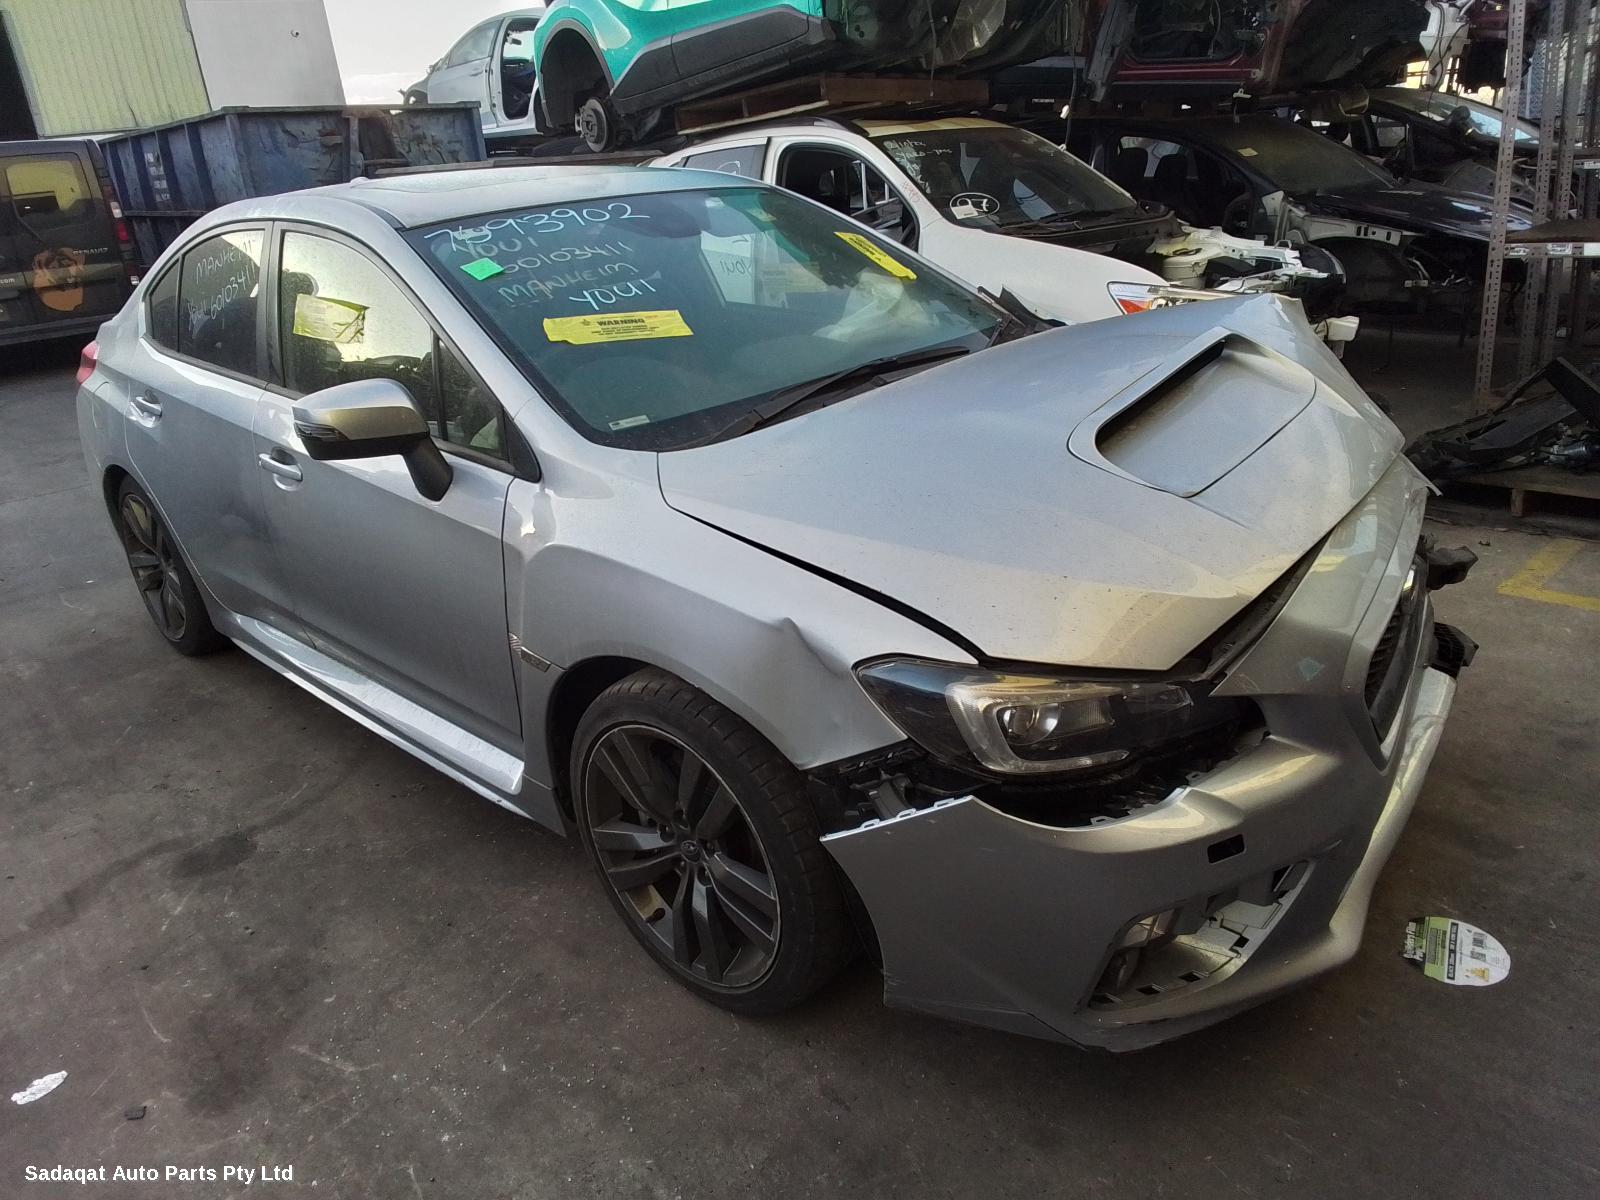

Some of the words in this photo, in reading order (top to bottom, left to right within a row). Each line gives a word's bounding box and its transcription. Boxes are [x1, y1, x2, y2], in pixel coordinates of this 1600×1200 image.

[497, 262, 639, 303] MANHEIM
[569, 279, 656, 311] YOUI
[597, 318, 646, 327] WARNING
